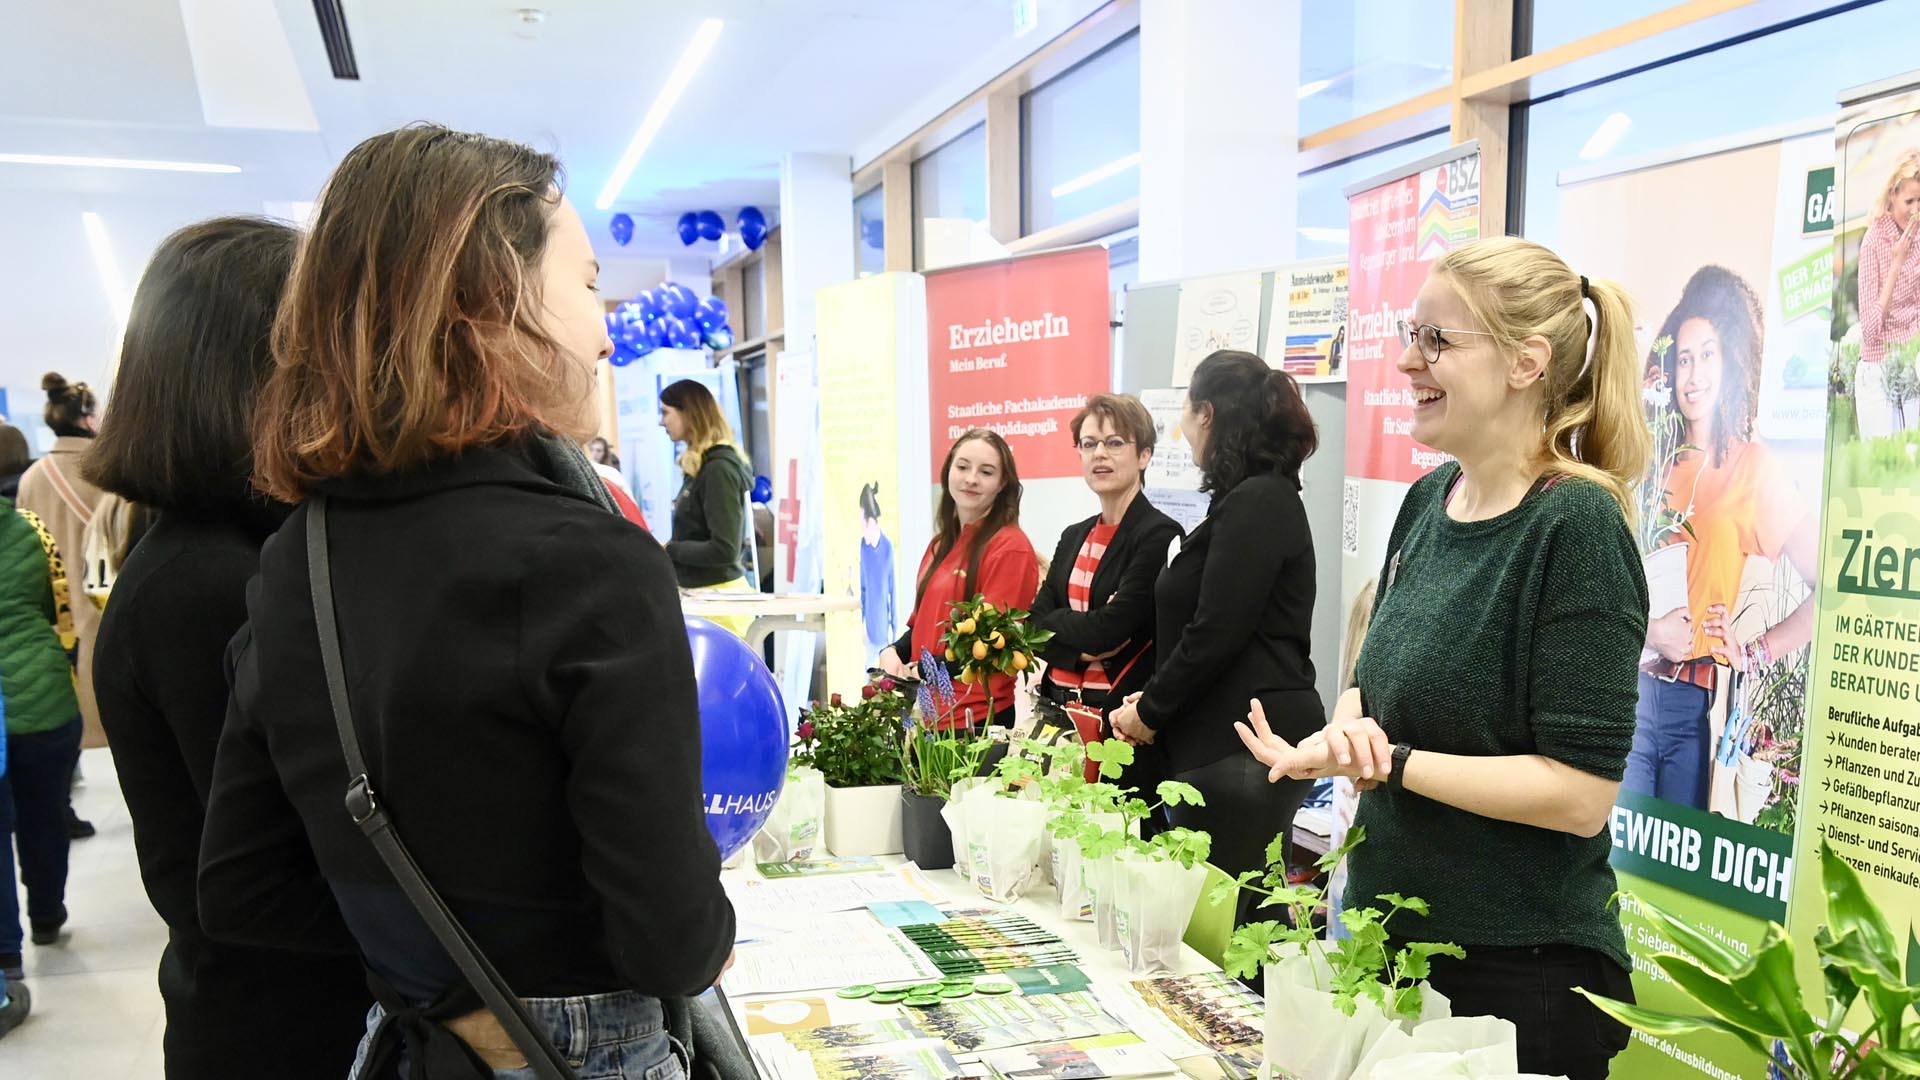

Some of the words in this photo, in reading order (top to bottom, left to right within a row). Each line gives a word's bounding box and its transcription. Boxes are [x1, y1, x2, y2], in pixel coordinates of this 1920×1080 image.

[1448, 157, 1479, 195] BSZ
[1783, 265, 1808, 289] DER
[949, 312, 1069, 350] ErzieherIn
[949, 358, 974, 373] Mein
[976, 353, 1007, 371] Beruf.
[948, 401, 1003, 419] Staatliche
[1364, 388, 1401, 407] Staatliche
[948, 424, 966, 440] für
[1383, 416, 1395, 435] für
[1835, 615, 1850, 634] IM
[1854, 614, 1920, 643] GÄRTNE
[1833, 643, 1859, 664] DER
[1863, 648, 1920, 673] KUNDE
[1830, 671, 1910, 701] BERATUNG
[1828, 706, 1880, 730] Berufliche
[1837, 731, 1877, 754] Kunden
[1835, 755, 1880, 779] Pflanzen
[1884, 770, 1904, 784] und
[1831, 802, 1876, 826] Pflanzen
[1879, 817, 1920, 838] saisona
[1828, 825, 1865, 846] Dienst-
[1868, 837, 1888, 853] und
[1608, 805, 1702, 872] EWIRB
[1711, 836, 1792, 903] DICH
[1874, 862, 1920, 889] einkaufe
[1637, 926, 1676, 954] Sieben
